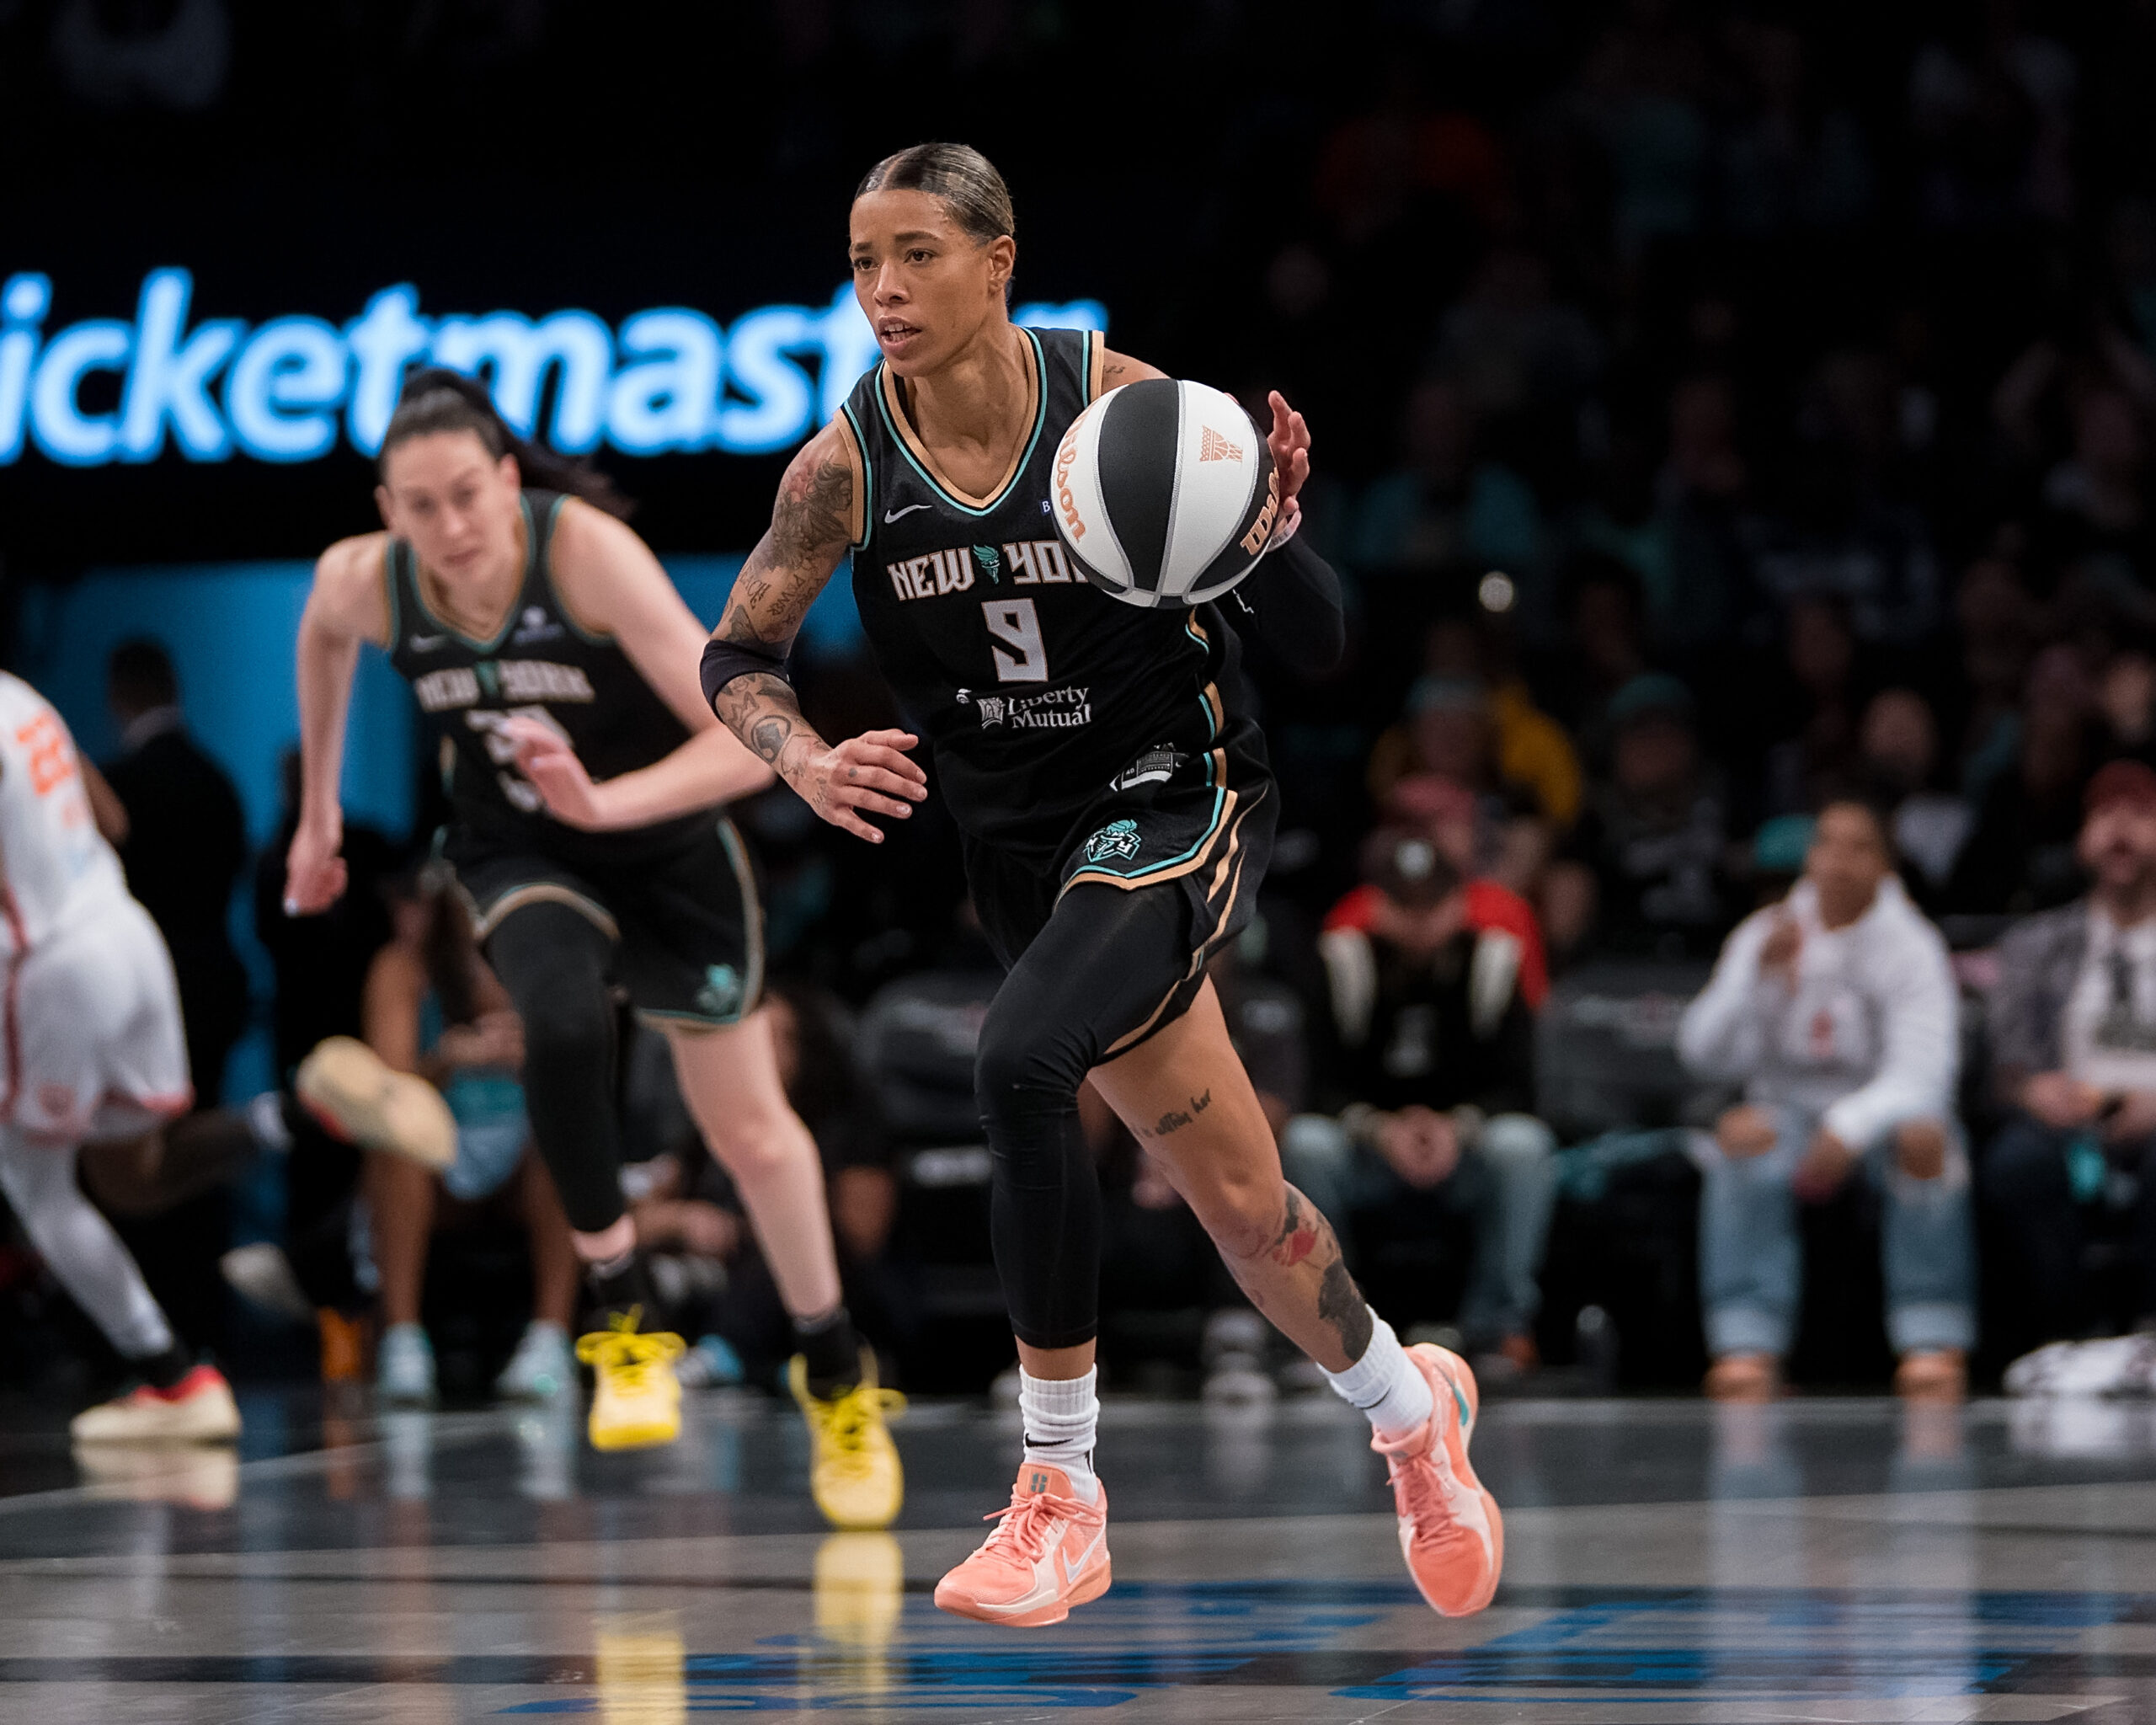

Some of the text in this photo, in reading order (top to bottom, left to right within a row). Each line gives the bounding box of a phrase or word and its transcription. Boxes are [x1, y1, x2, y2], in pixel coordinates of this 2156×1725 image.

[0, 265, 1109, 468] icketmast
[887, 547, 975, 601] NEW
[1002, 540, 1089, 585] YO
[981, 597, 1049, 682] 9
[1011, 703, 1092, 729] Mutual
